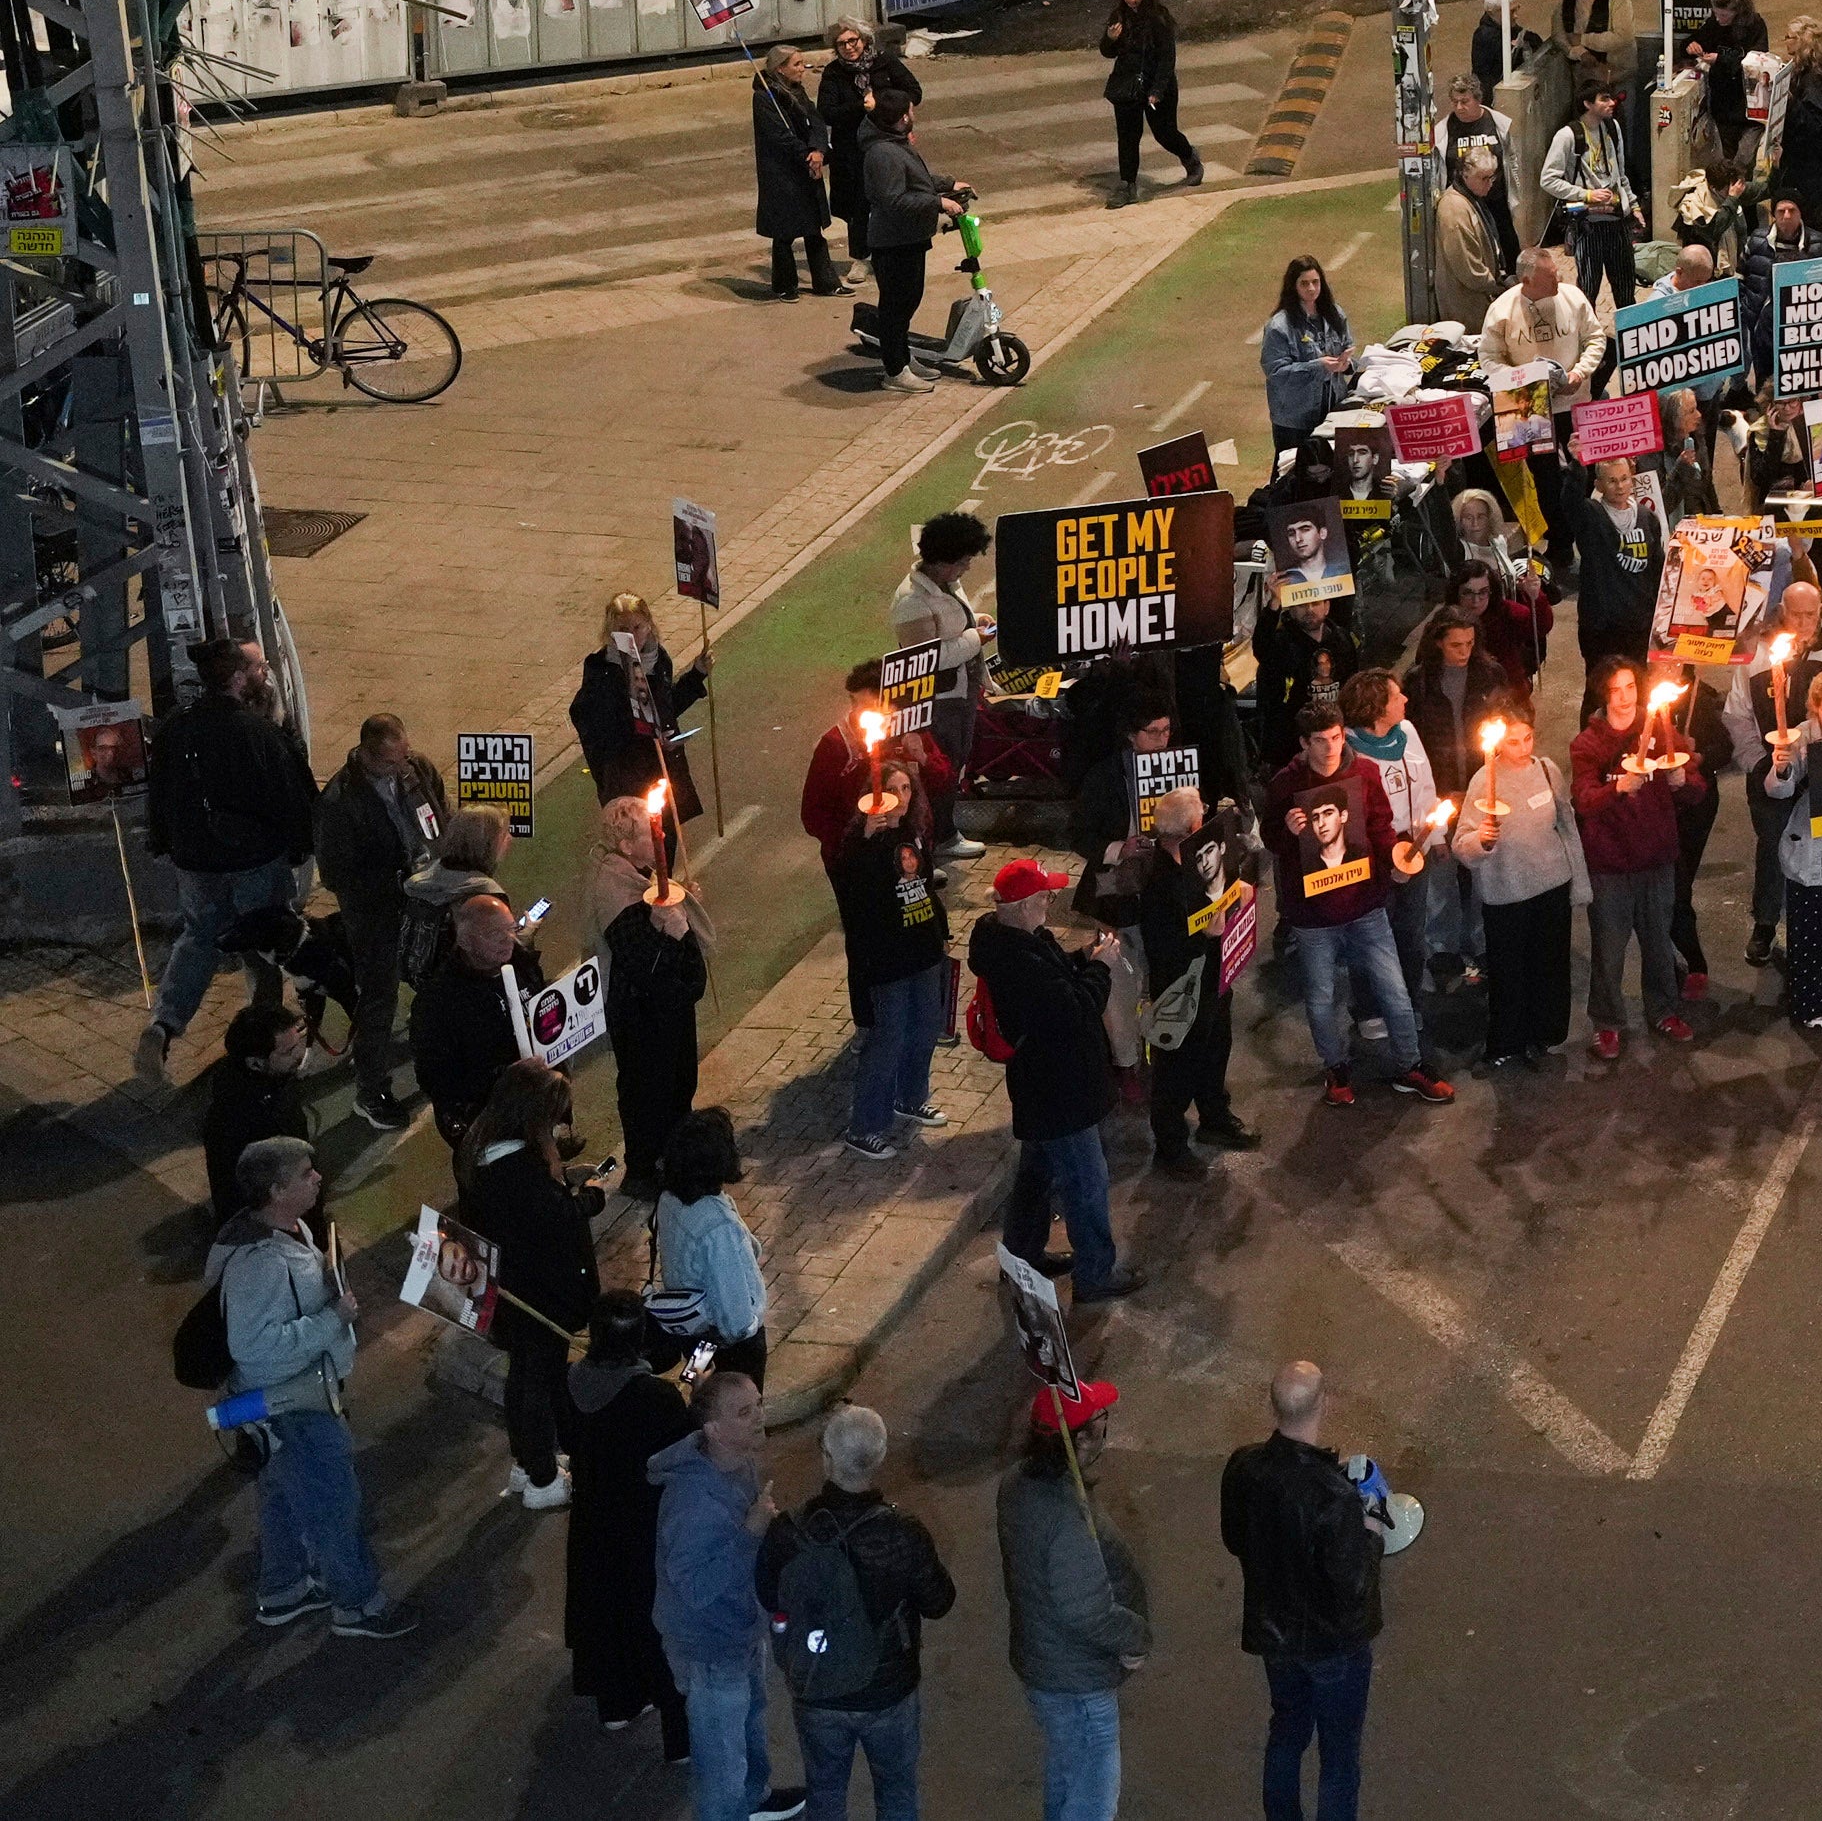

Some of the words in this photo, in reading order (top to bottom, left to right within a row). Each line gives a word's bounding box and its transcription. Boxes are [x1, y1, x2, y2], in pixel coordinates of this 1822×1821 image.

[1622, 319, 1678, 359] END
[1683, 300, 1736, 340] THE
[1622, 338, 1741, 396] BLOODSHED
[1055, 514, 1116, 562] GET
[1130, 507, 1176, 554] MY
[1055, 551, 1177, 605] PEOPLE
[1055, 593, 1178, 655] HOME!
[883, 660, 905, 688] הם
[907, 647, 938, 679] למה
[882, 674, 935, 705] עדיין
[460, 735, 530, 761] הימים
[1136, 747, 1199, 777] הימים
[460, 761, 531, 780] מתרבים
[460, 781, 530, 799] החטופים
[1310, 872, 1344, 889] אלכסנדר
[1346, 867, 1362, 880] עידן
